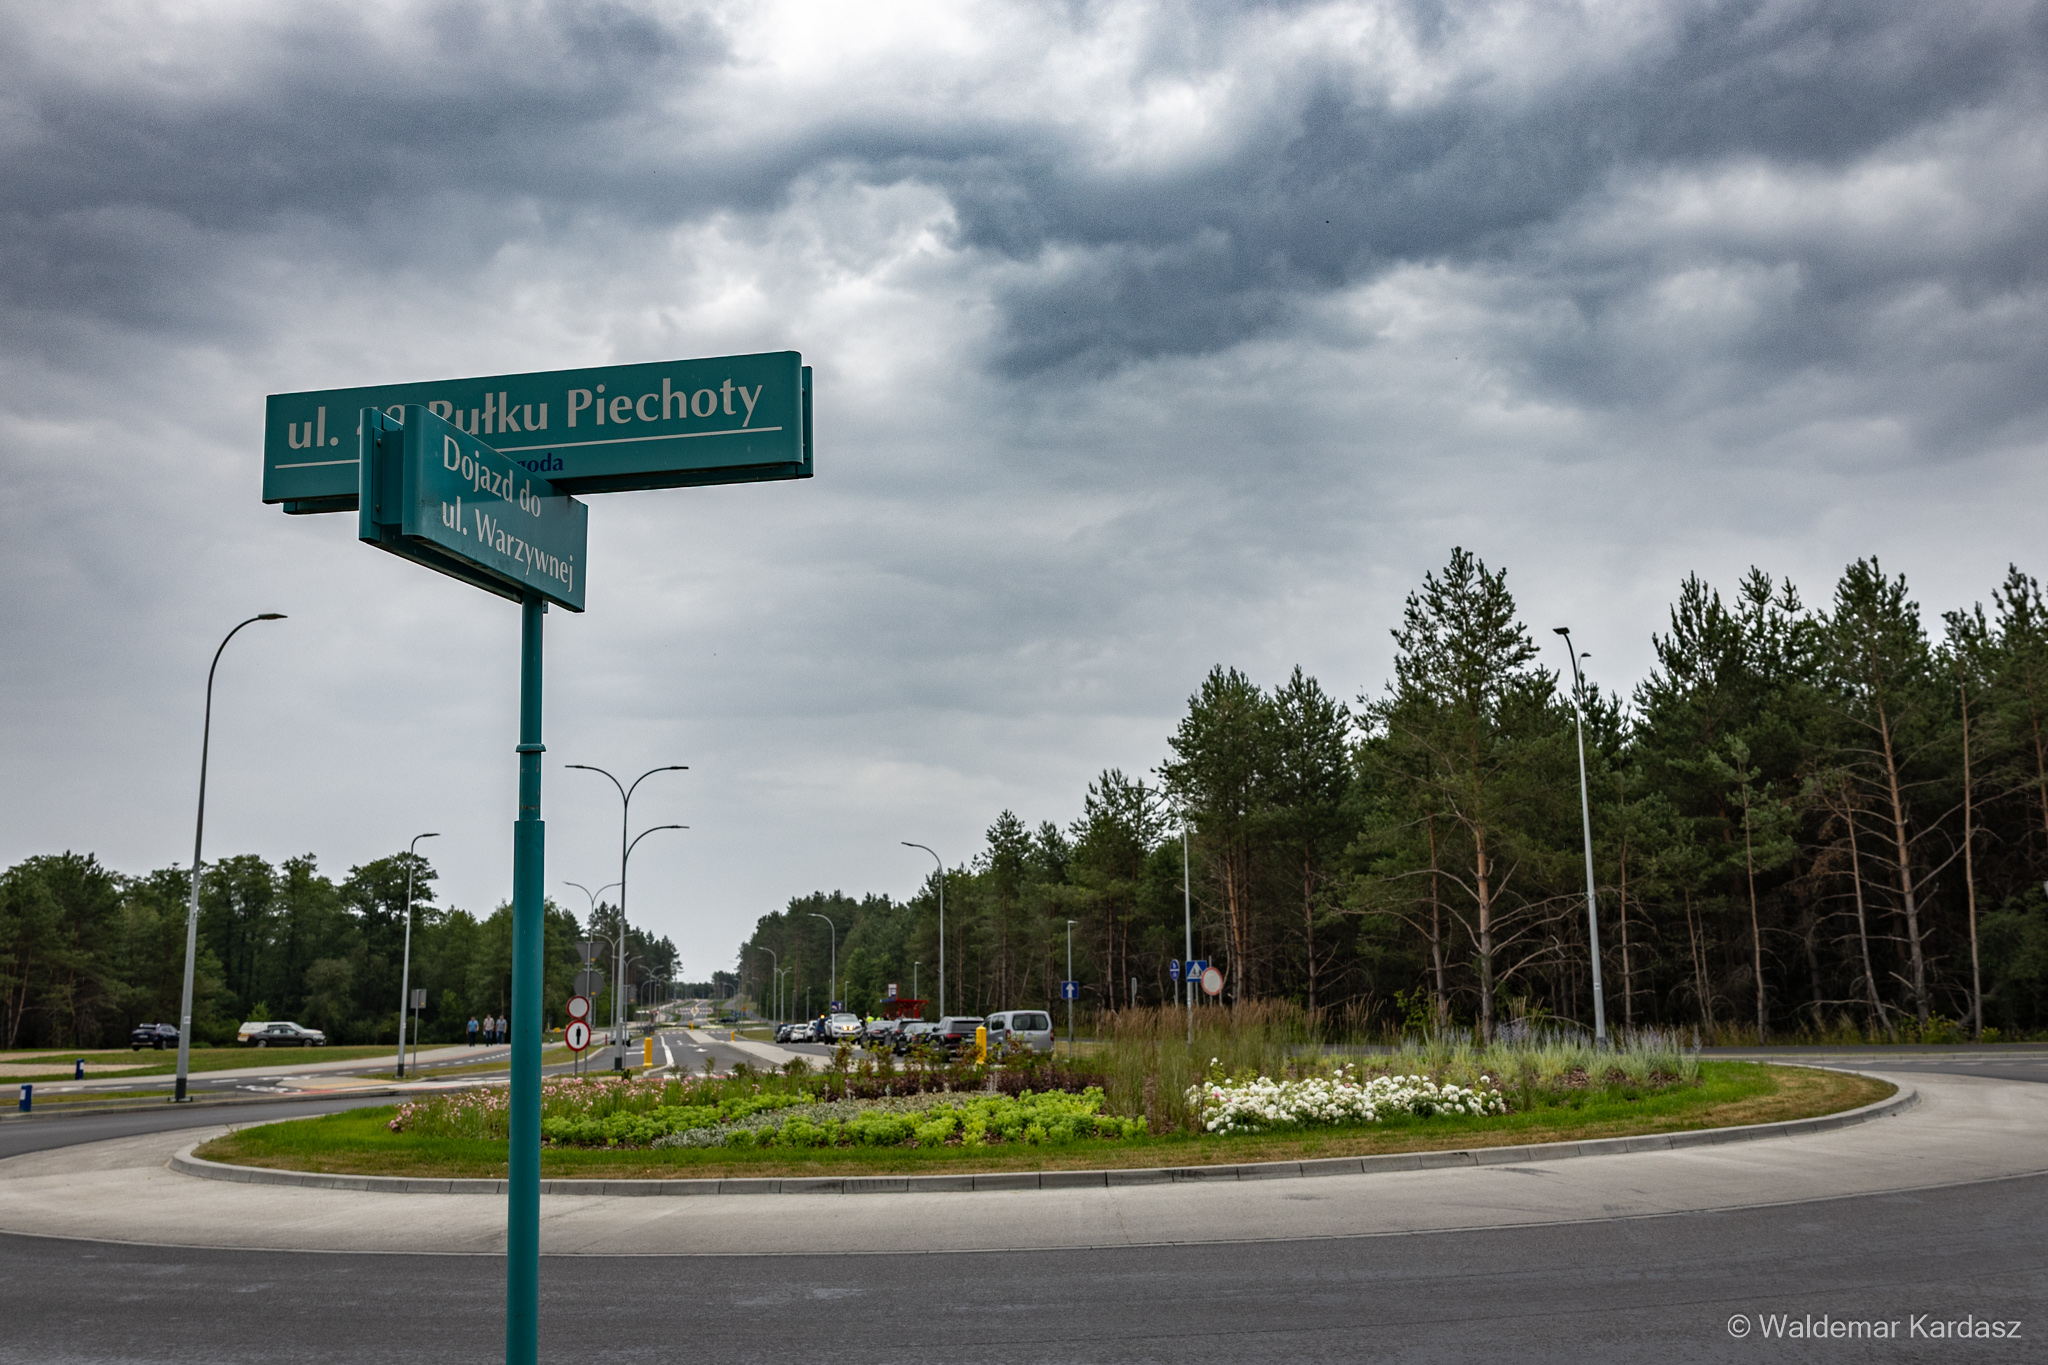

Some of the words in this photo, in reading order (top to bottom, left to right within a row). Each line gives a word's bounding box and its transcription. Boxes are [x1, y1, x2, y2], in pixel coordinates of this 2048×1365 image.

[287, 406, 339, 450] ul.
[566, 377, 763, 428] Piechoty
[443, 434, 514, 503] Dojazd
[519, 479, 541, 518] do
[442, 495, 468, 536] ul.
[475, 509, 574, 593] Warzywnej
